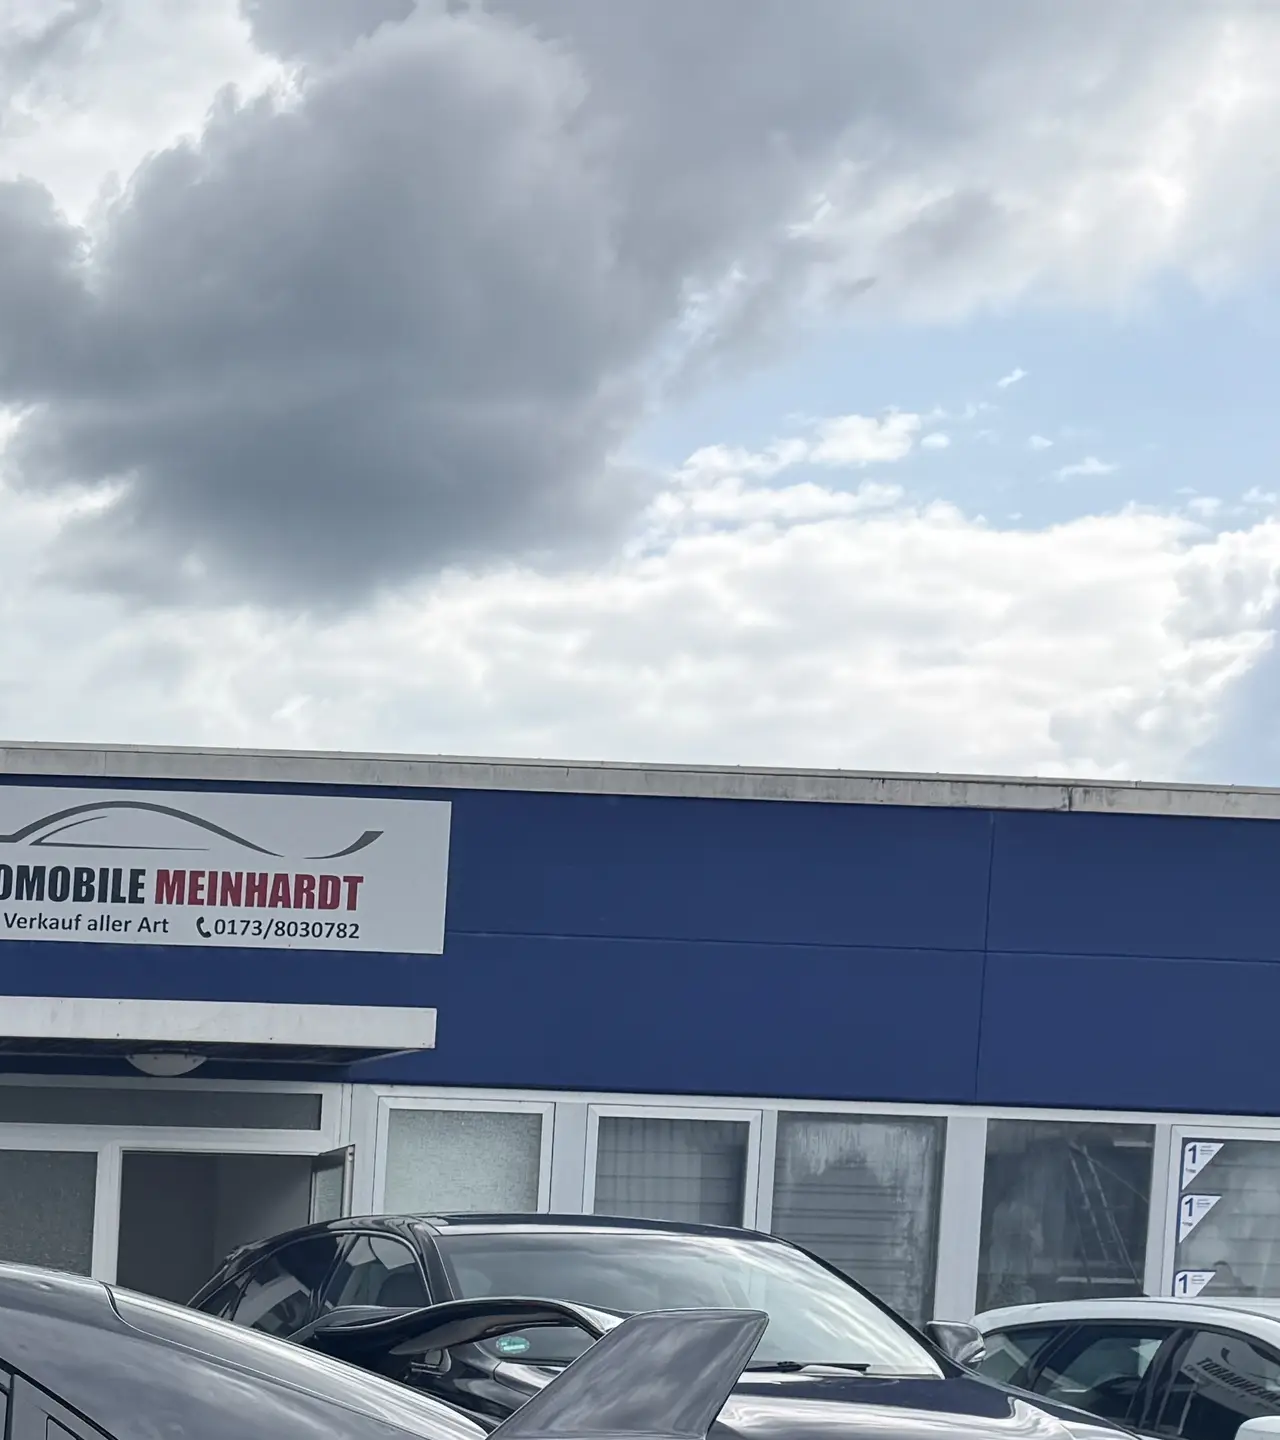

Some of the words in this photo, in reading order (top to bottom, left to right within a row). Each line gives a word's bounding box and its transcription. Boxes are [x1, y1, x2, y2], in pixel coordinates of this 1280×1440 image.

[154, 869, 364, 911] MEINHARDT
[4, 912, 82, 931] Verkauf
[87, 914, 132, 932] aller
[137, 916, 169, 933] Art
[214, 918, 360, 940] 0173/8030782
[1188, 1144, 1197, 1164] 1
[1184, 1197, 1194, 1217] 1
[1178, 1273, 1188, 1294] 1
